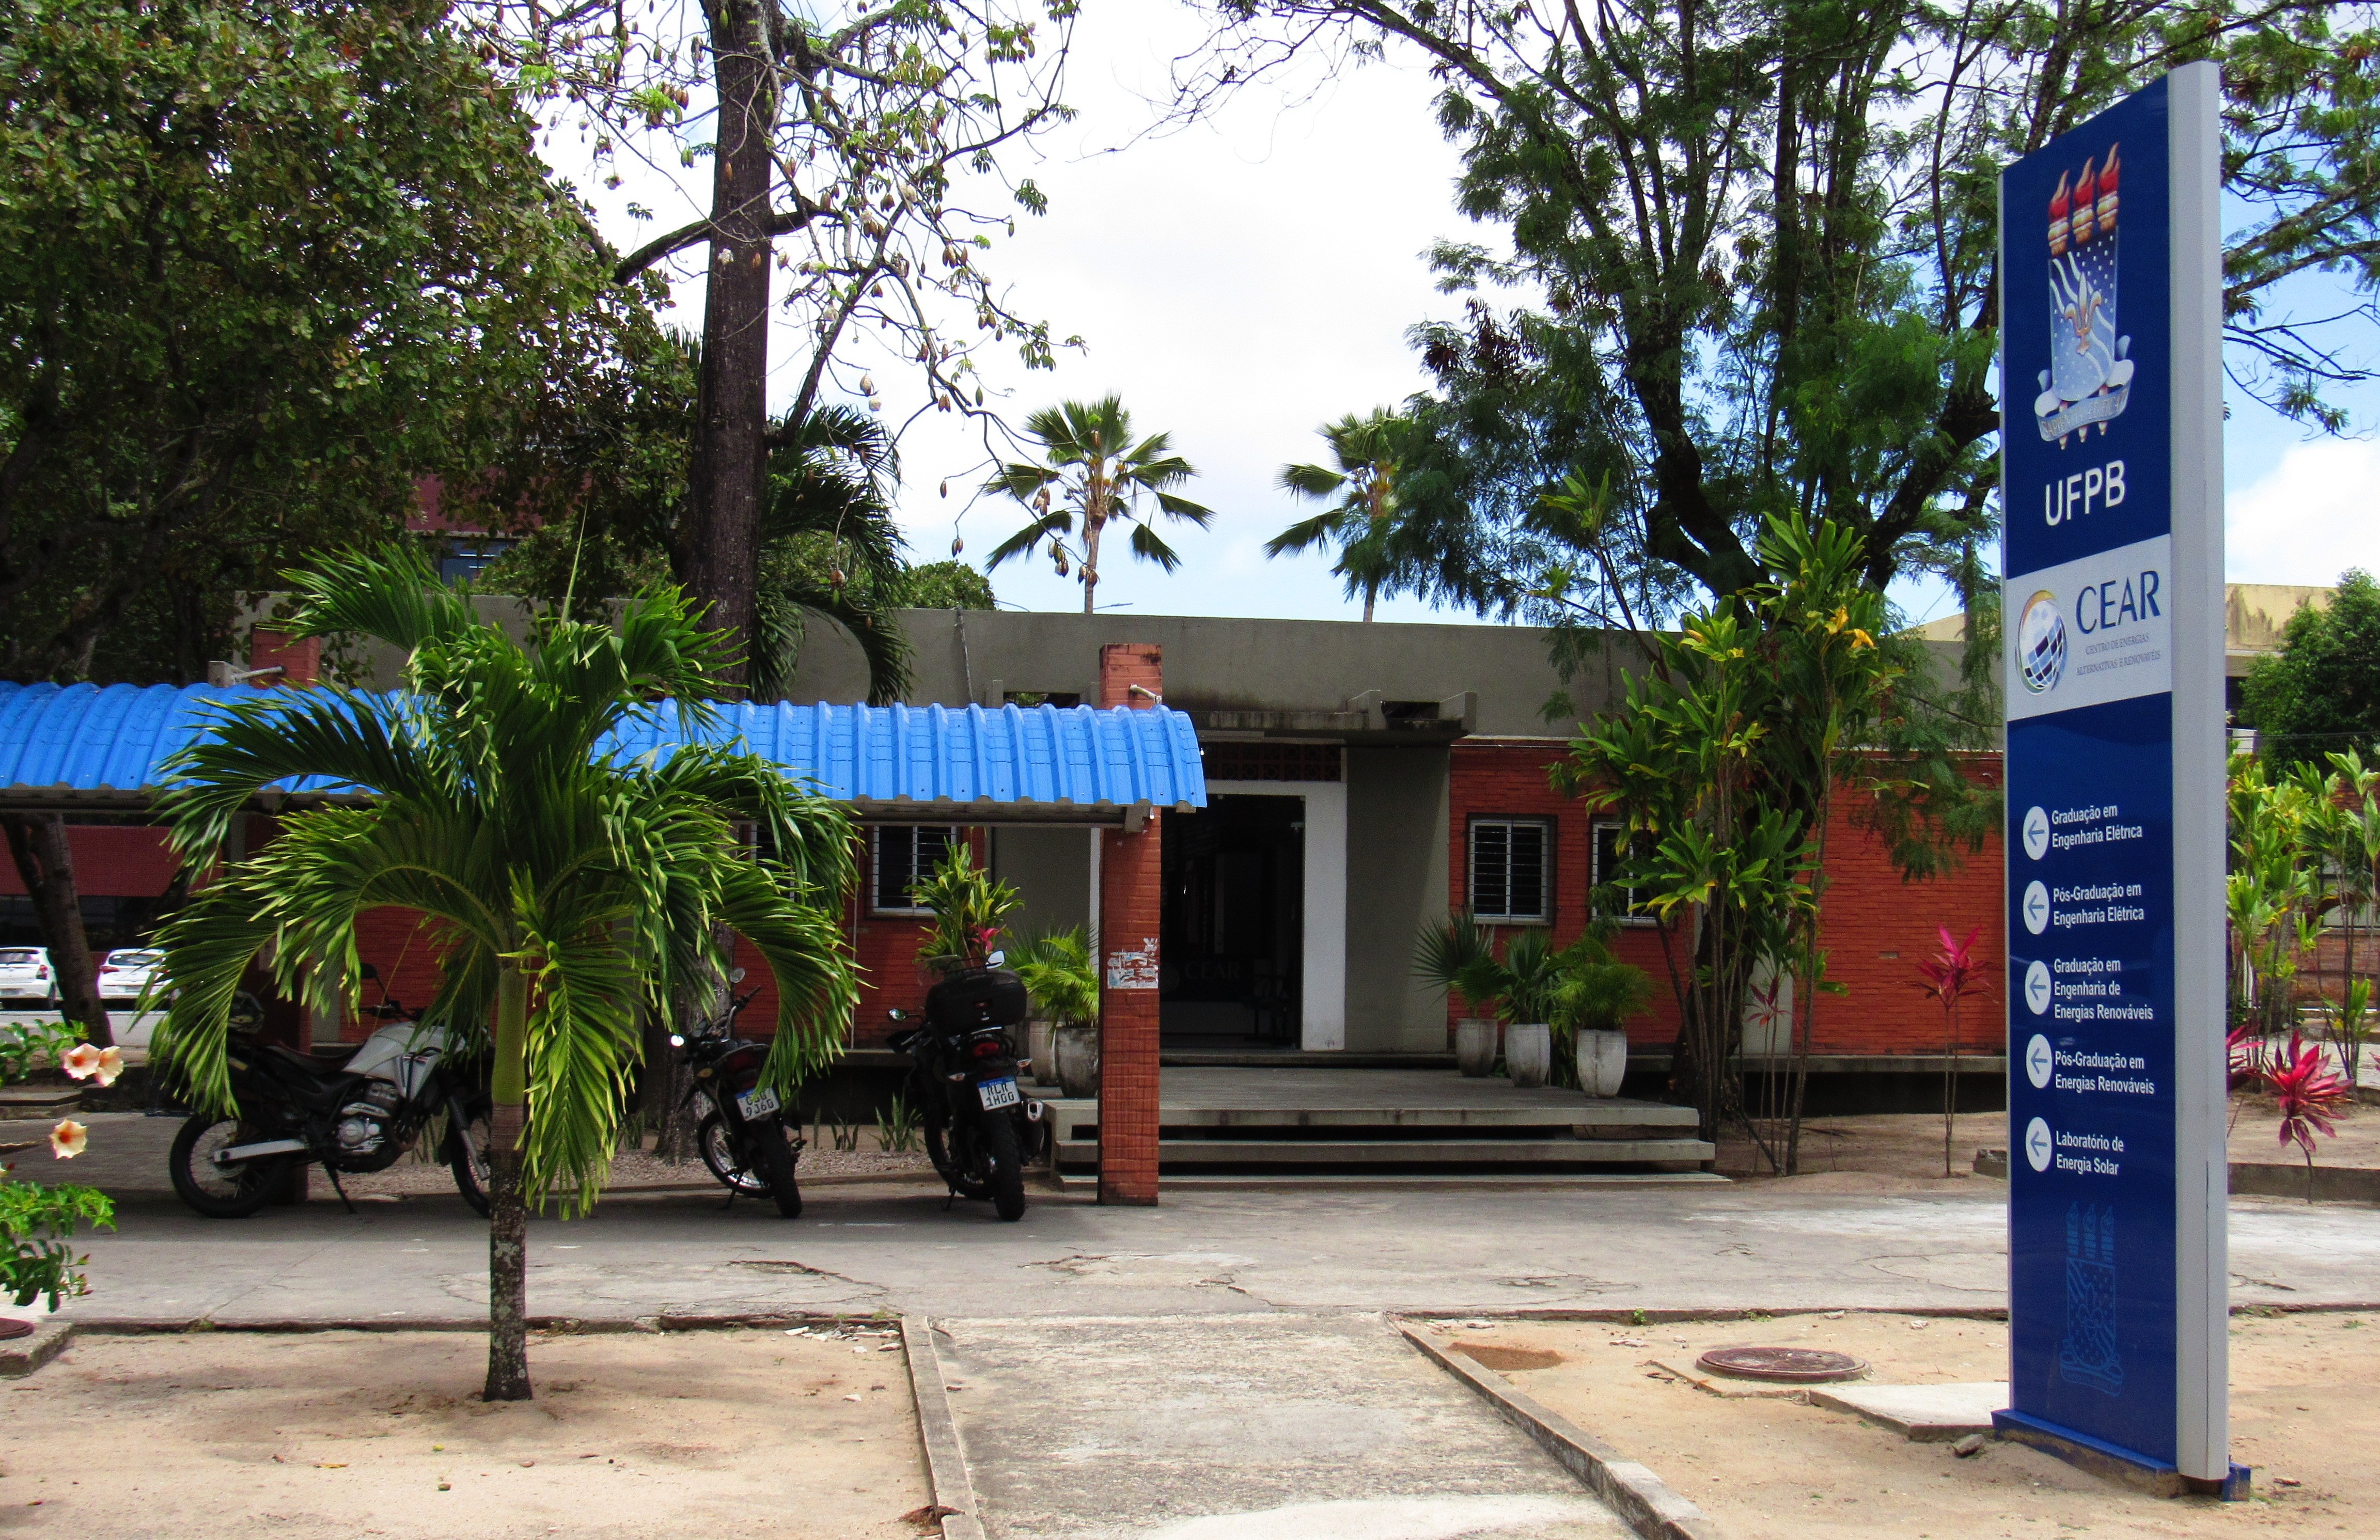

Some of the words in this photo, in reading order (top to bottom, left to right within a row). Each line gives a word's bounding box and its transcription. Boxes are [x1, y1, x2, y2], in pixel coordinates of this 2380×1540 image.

[2045, 460, 2125, 526] UFPB
[2076, 570, 2160, 634] CEAR
[2052, 805, 2101, 825] Graduação
[2103, 805, 2118, 817] em
[2052, 828, 2103, 851] Engenharia
[2106, 824, 2143, 841] Elétrica
[2053, 883, 2124, 903] Pós-Graduação
[2126, 884, 2142, 895] em
[2054, 908, 2105, 929] Engenharia
[2107, 905, 2144, 922] Elétrica
[2054, 957, 2104, 977] Graduação
[2106, 959, 2121, 971] em
[2055, 981, 2107, 999] Engenharia
[2109, 981, 2121, 995] de
[2055, 1004, 2094, 1023] Energias
[2097, 1003, 2154, 1020] Renováveis
[2055, 1050, 2126, 1072] Pós-Graduação
[2130, 1057, 2144, 1070] em
[987, 1082, 1008, 1096] RLR
[2056, 1074, 2095, 1093] Energias
[2098, 1076, 2155, 1094] Renováveis
[2056, 1130, 2109, 1151] Laboratório
[2112, 1136, 2124, 1152] de
[2057, 1154, 2092, 1175] Energia
[2094, 1157, 2119, 1175] Solar
